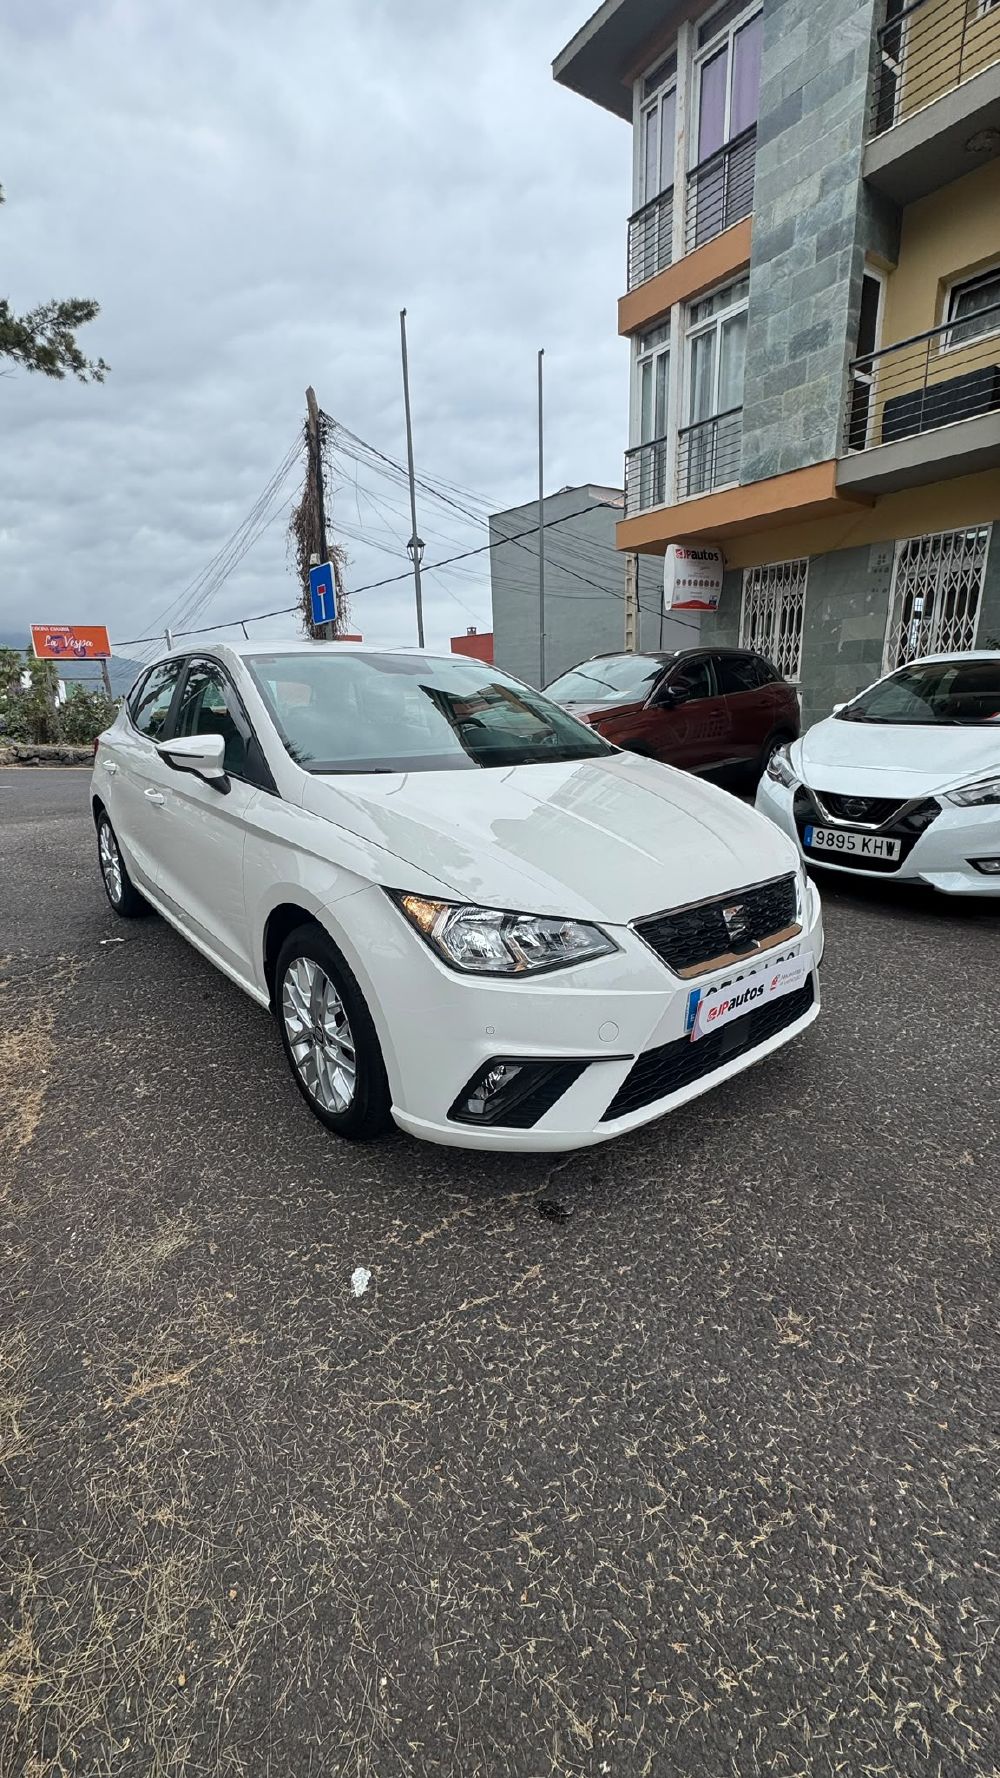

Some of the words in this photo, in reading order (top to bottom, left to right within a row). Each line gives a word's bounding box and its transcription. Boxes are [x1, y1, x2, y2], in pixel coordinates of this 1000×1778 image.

[44, 635, 58, 647] La
[64, 635, 93, 651] Vespa
[816, 831, 855, 850] 9895
[862, 837, 895, 856] KHW
[717, 983, 765, 1017] JPautos
